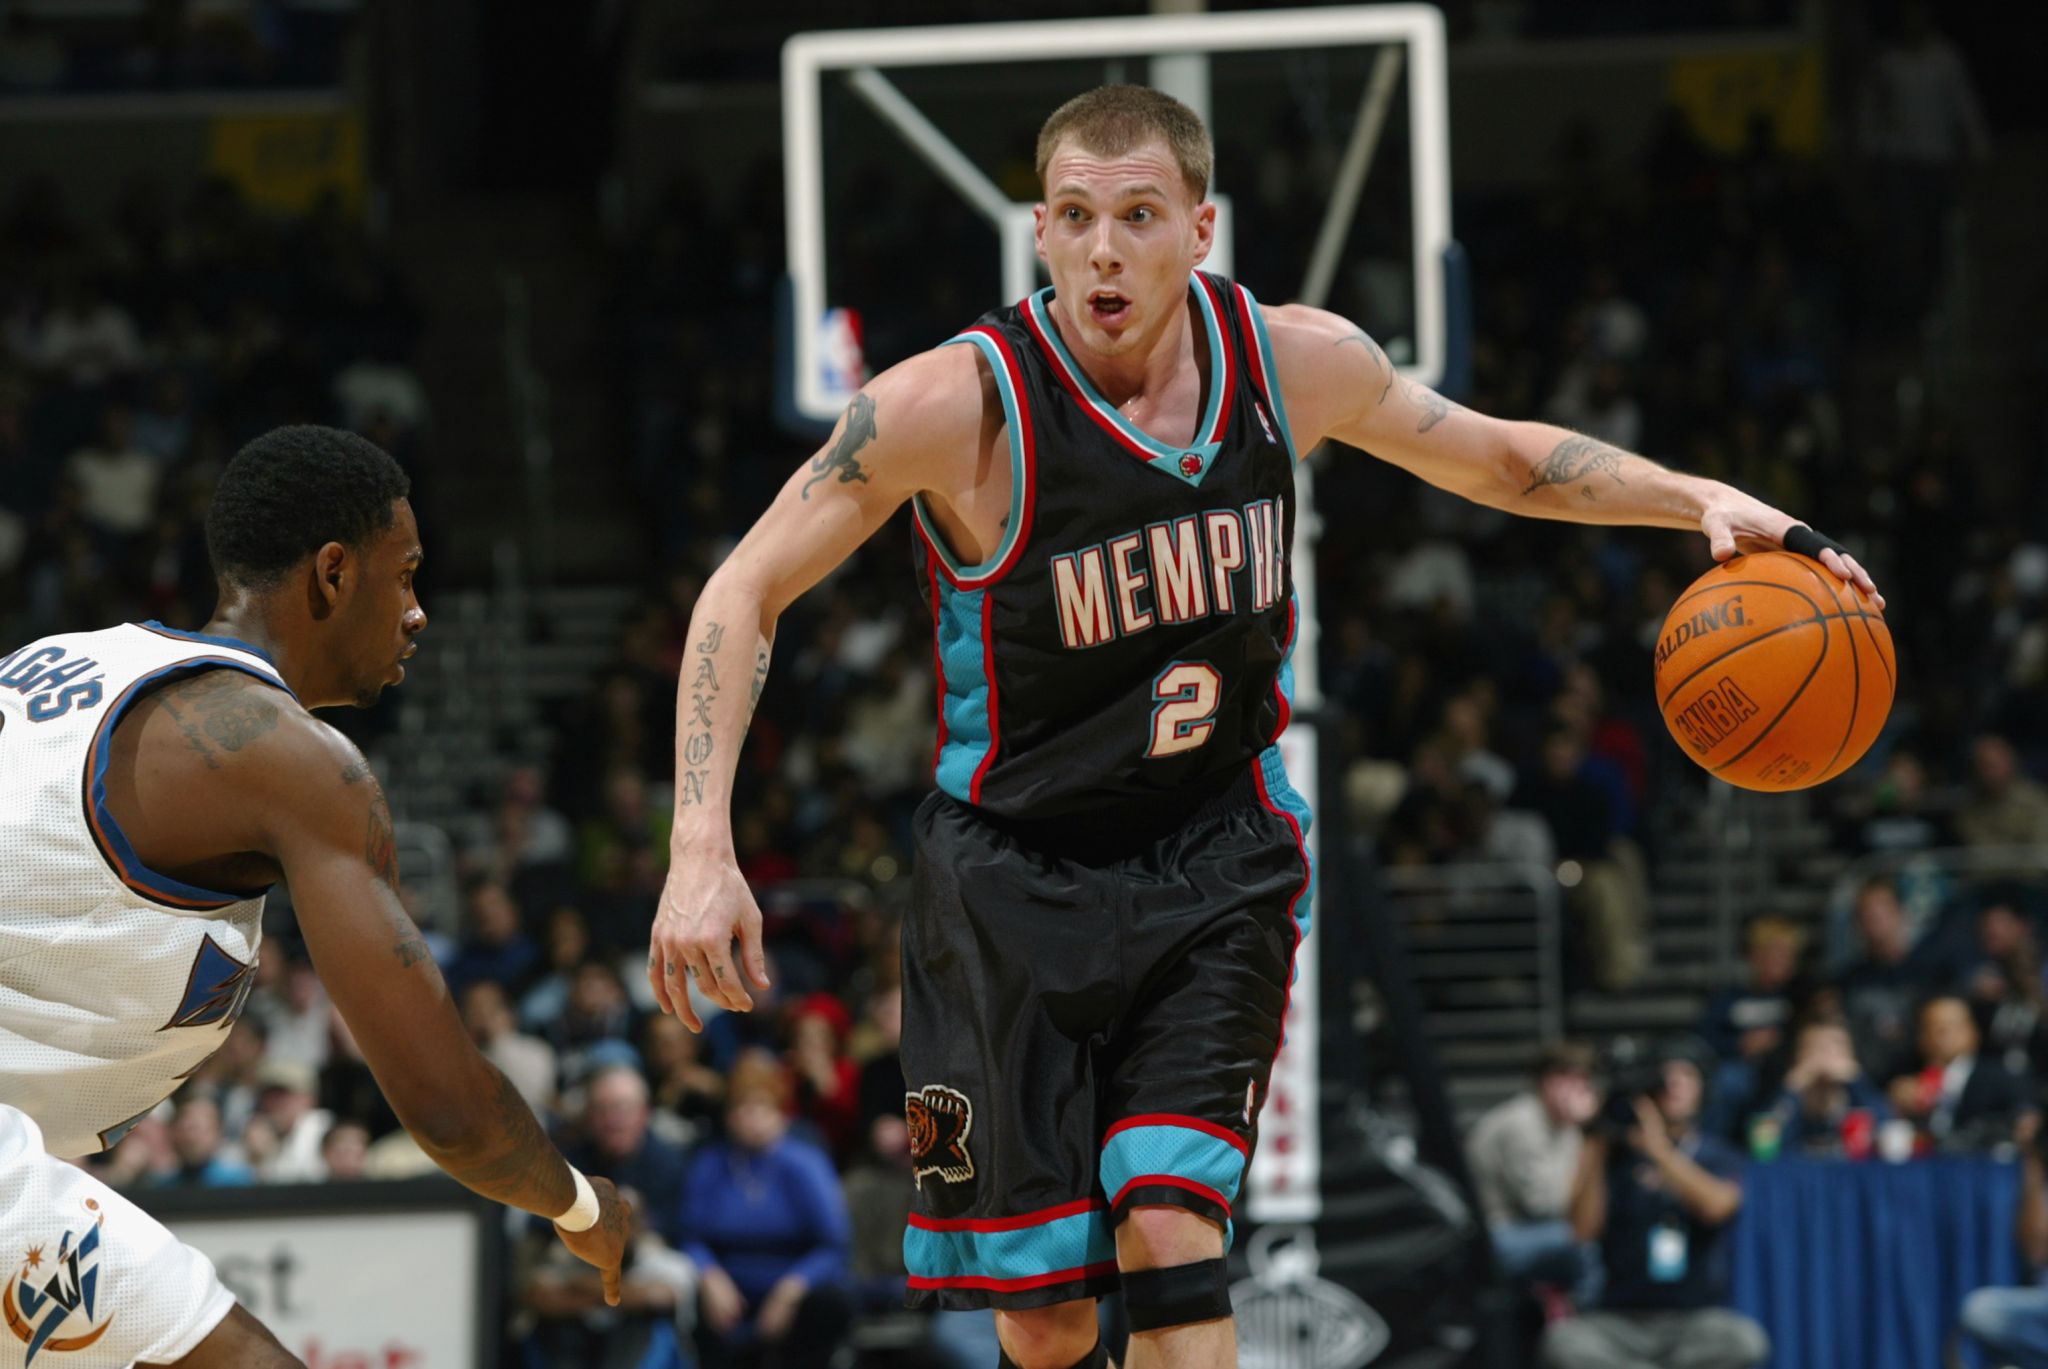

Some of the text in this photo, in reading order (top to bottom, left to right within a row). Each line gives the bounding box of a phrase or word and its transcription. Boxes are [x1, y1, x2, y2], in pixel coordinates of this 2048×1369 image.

[681, 621, 726, 806] JAXON
[1142, 660, 1223, 759] 2
[1683, 675, 1760, 749] NBA
